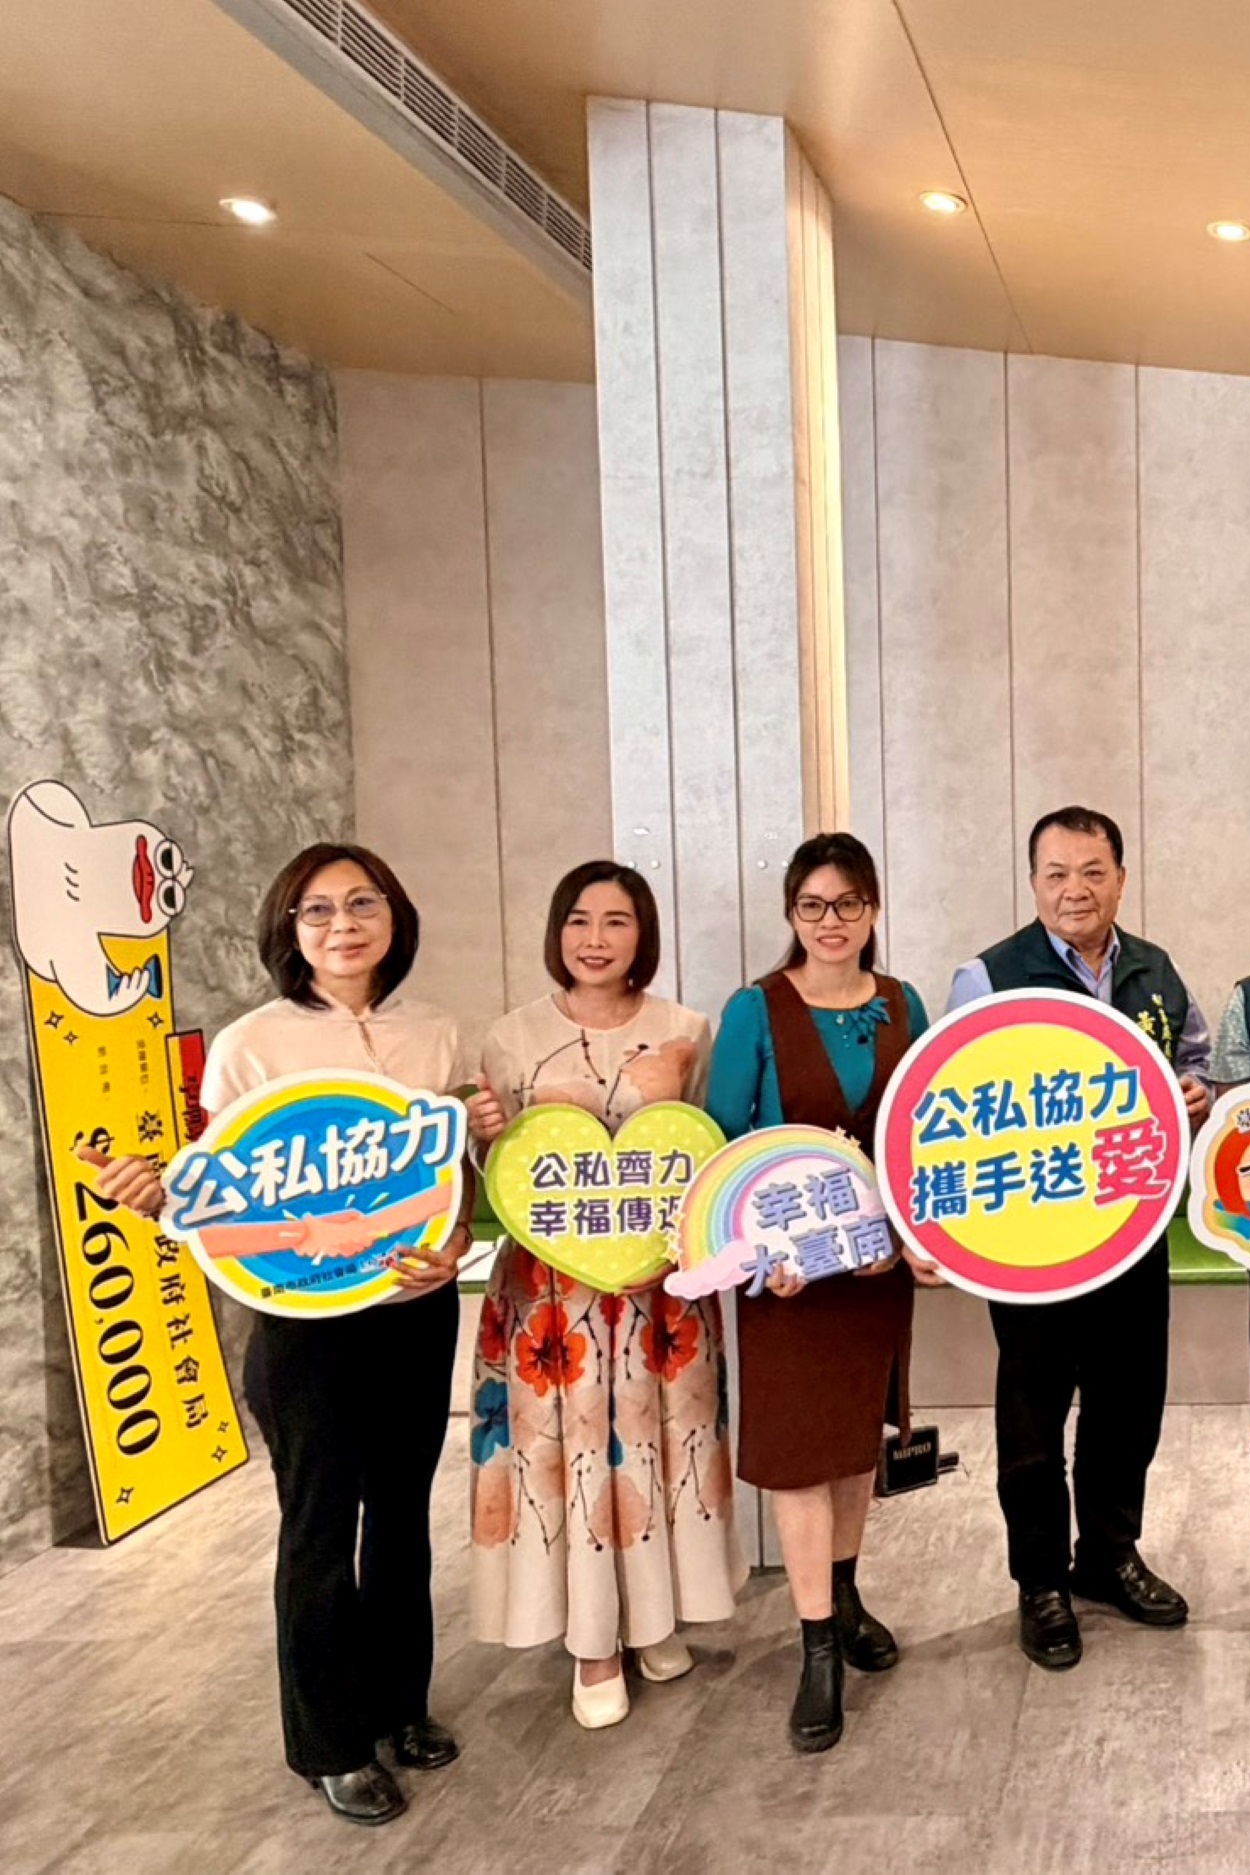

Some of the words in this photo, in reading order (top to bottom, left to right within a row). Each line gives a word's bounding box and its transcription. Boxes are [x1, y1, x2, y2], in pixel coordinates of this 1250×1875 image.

[914, 1062, 1138, 1144] 公私協力
[176, 1103, 449, 1226] 公私協力
[530, 1150, 694, 1188] 公私齊力
[753, 1167, 859, 1232] 幸福
[912, 1117, 1171, 1222] 攜手送愛
[137, 1107, 211, 1431] 臺政府社會局
[741, 1213, 894, 1297] 大臺南
